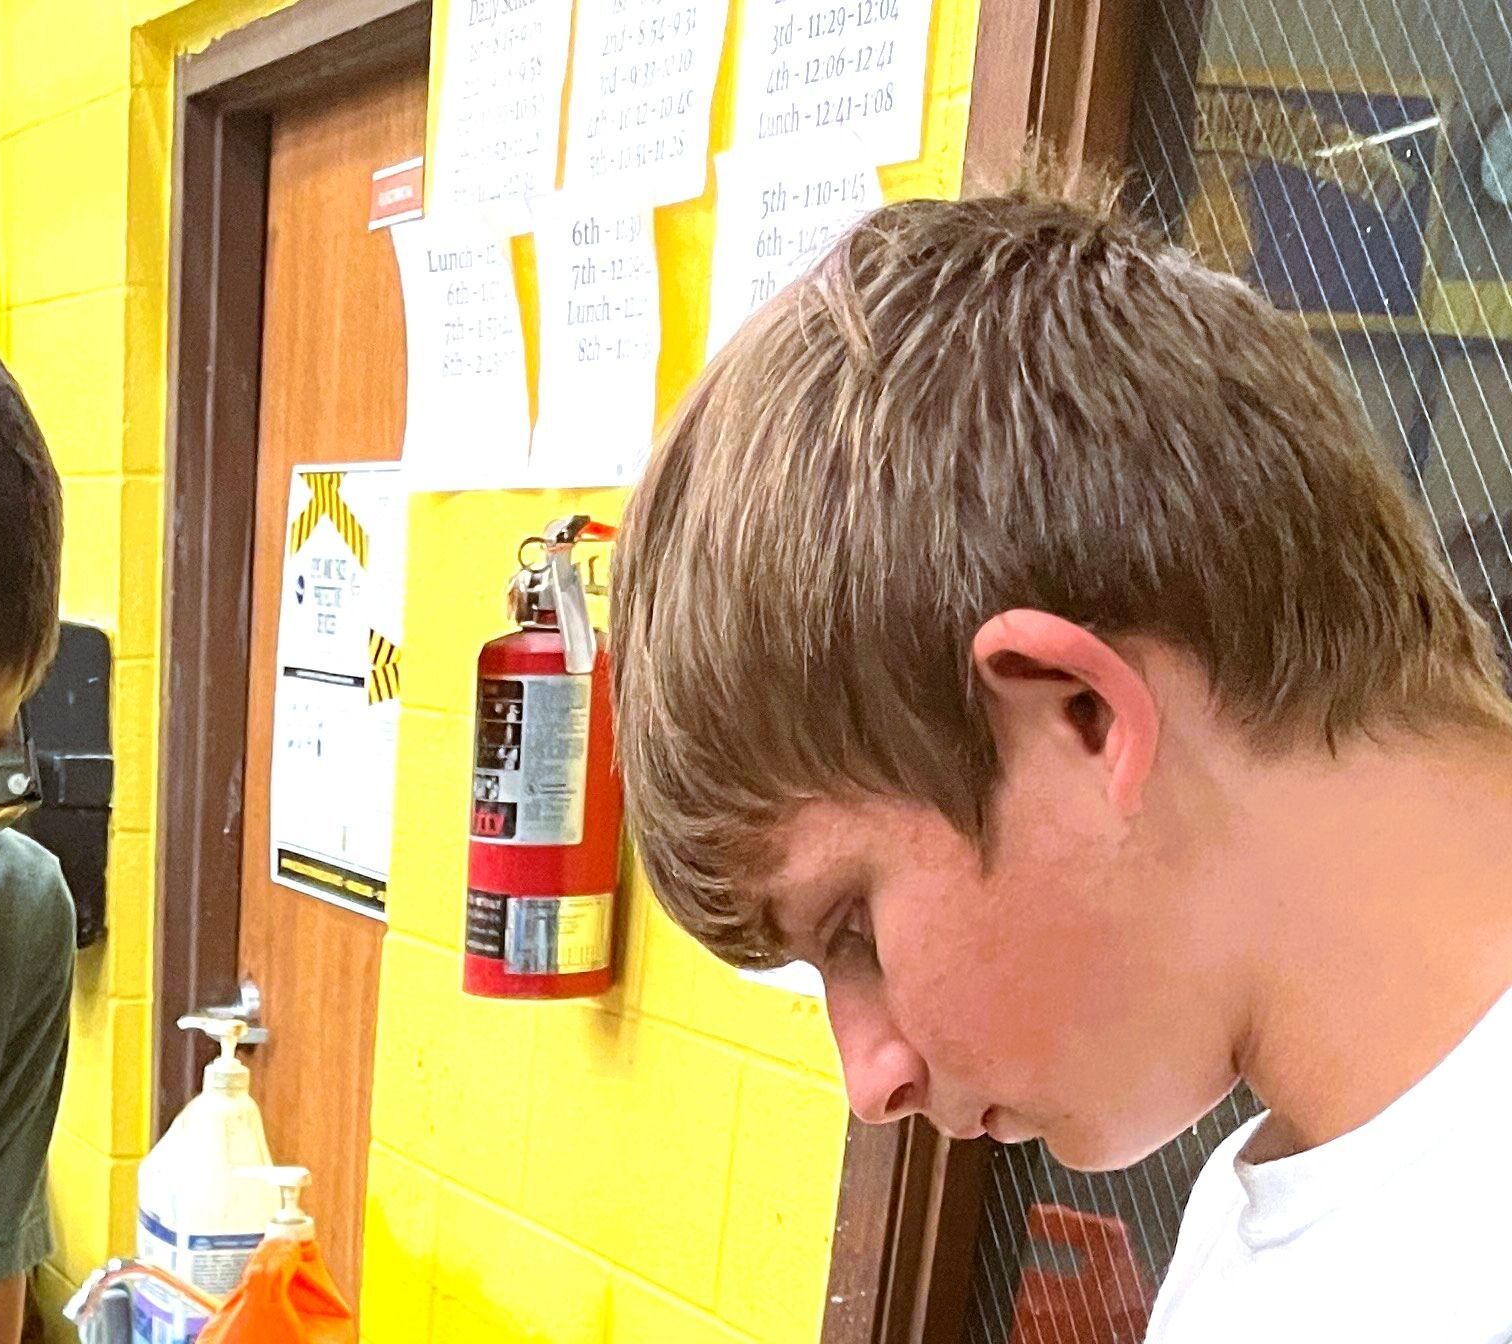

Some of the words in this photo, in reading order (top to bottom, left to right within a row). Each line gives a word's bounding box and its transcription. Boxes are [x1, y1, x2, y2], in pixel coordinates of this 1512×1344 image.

[770, 13, 794, 55] 3rd
[766, 60, 790, 95] 4th
[757, 102, 801, 140] Lunch
[760, 181, 787, 220] 5th
[571, 216, 601, 248] 6th
[756, 226, 783, 258] 6th
[571, 257, 597, 291] 7th
[567, 294, 611, 326] Lunch
